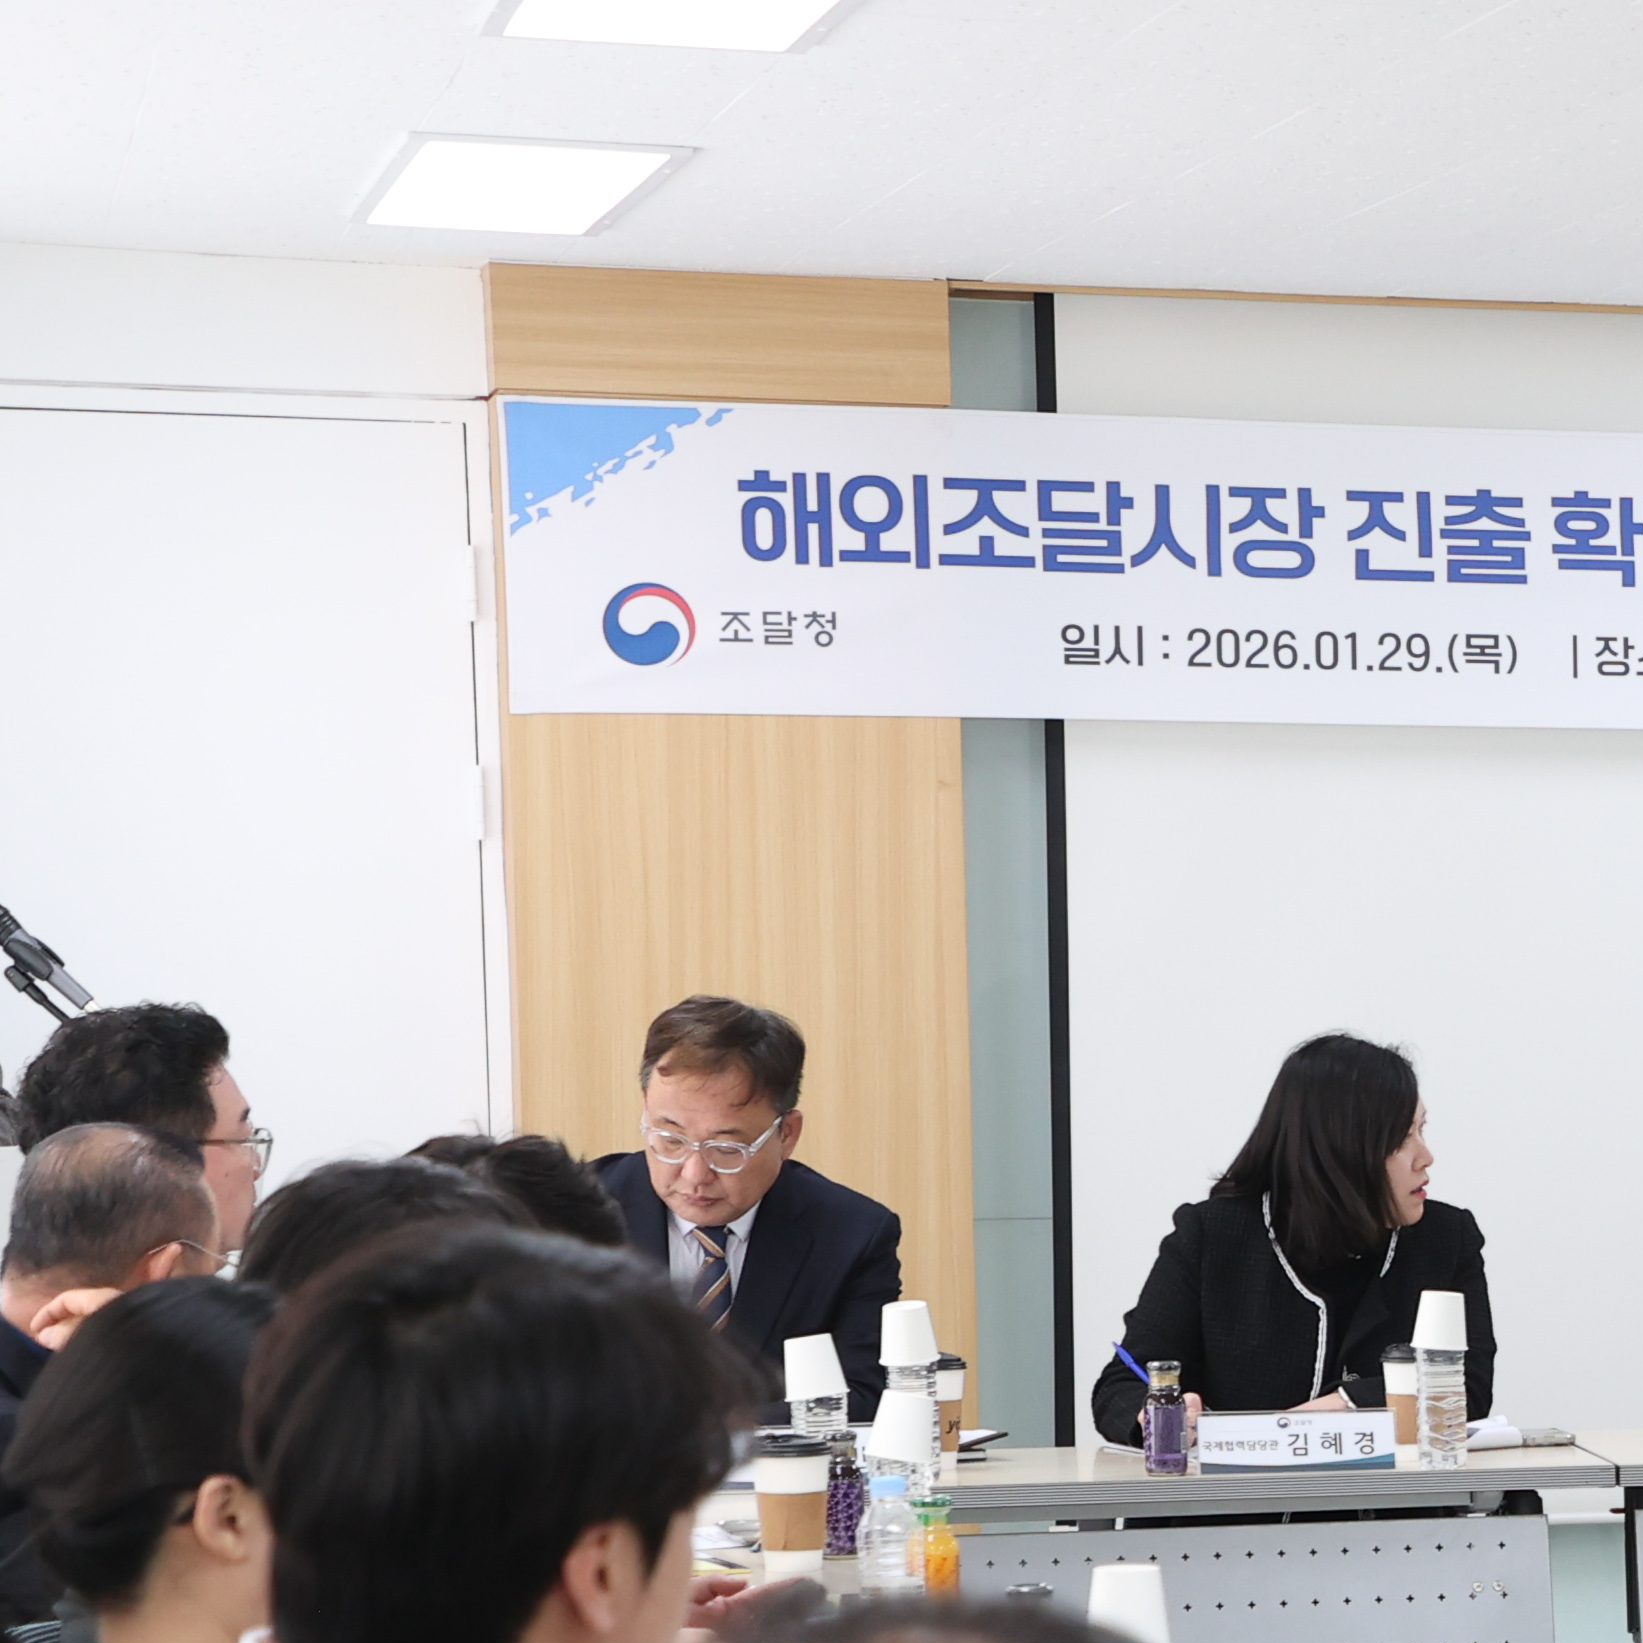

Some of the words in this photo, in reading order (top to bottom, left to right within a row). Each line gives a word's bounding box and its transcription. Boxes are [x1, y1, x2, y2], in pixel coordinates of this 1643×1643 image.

[737, 469, 1326, 579] 해외조달시장
[1345, 489, 1532, 585] 진출
[718, 609, 838, 649] 조달청
[1060, 623, 1145, 667] 일시
[1187, 627, 1518, 675] 2026.01.29.(목)
